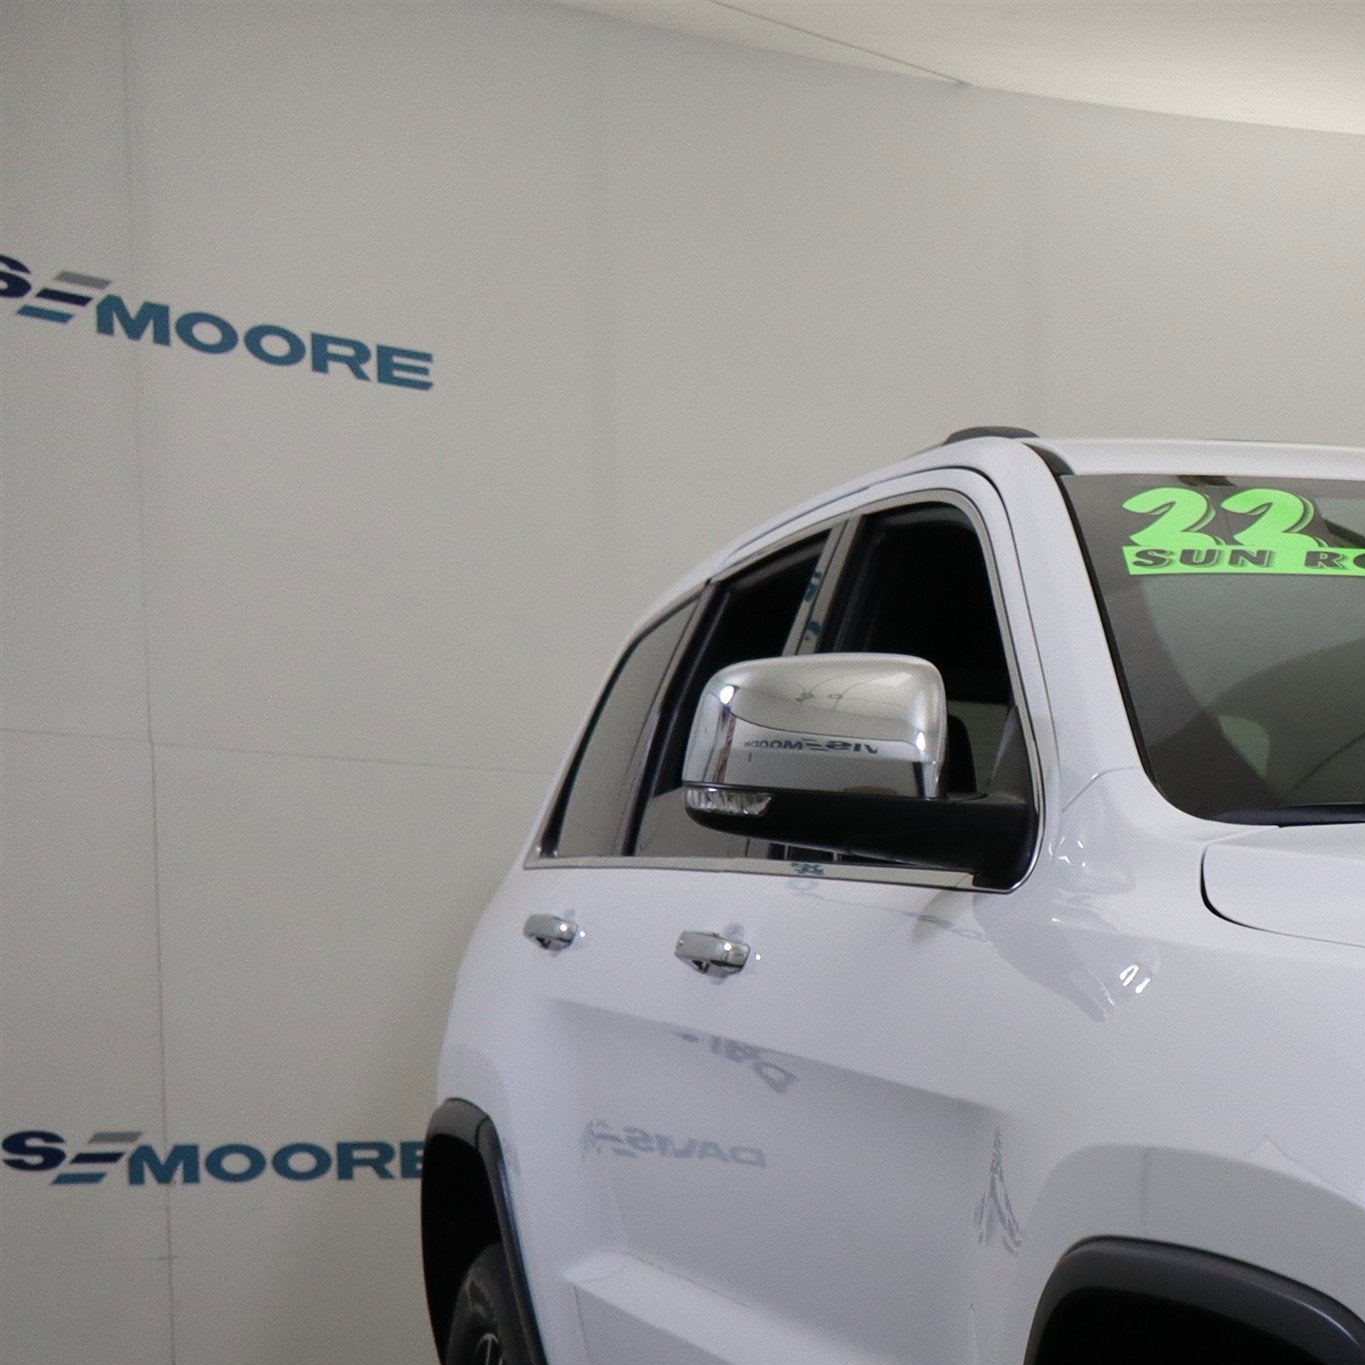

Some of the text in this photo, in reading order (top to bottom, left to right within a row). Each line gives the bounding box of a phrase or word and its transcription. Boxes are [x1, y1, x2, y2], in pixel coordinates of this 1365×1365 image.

[96, 294, 433, 391] MOORE
[1121, 486, 1328, 548] 22
[1132, 548, 1272, 569] SUN
